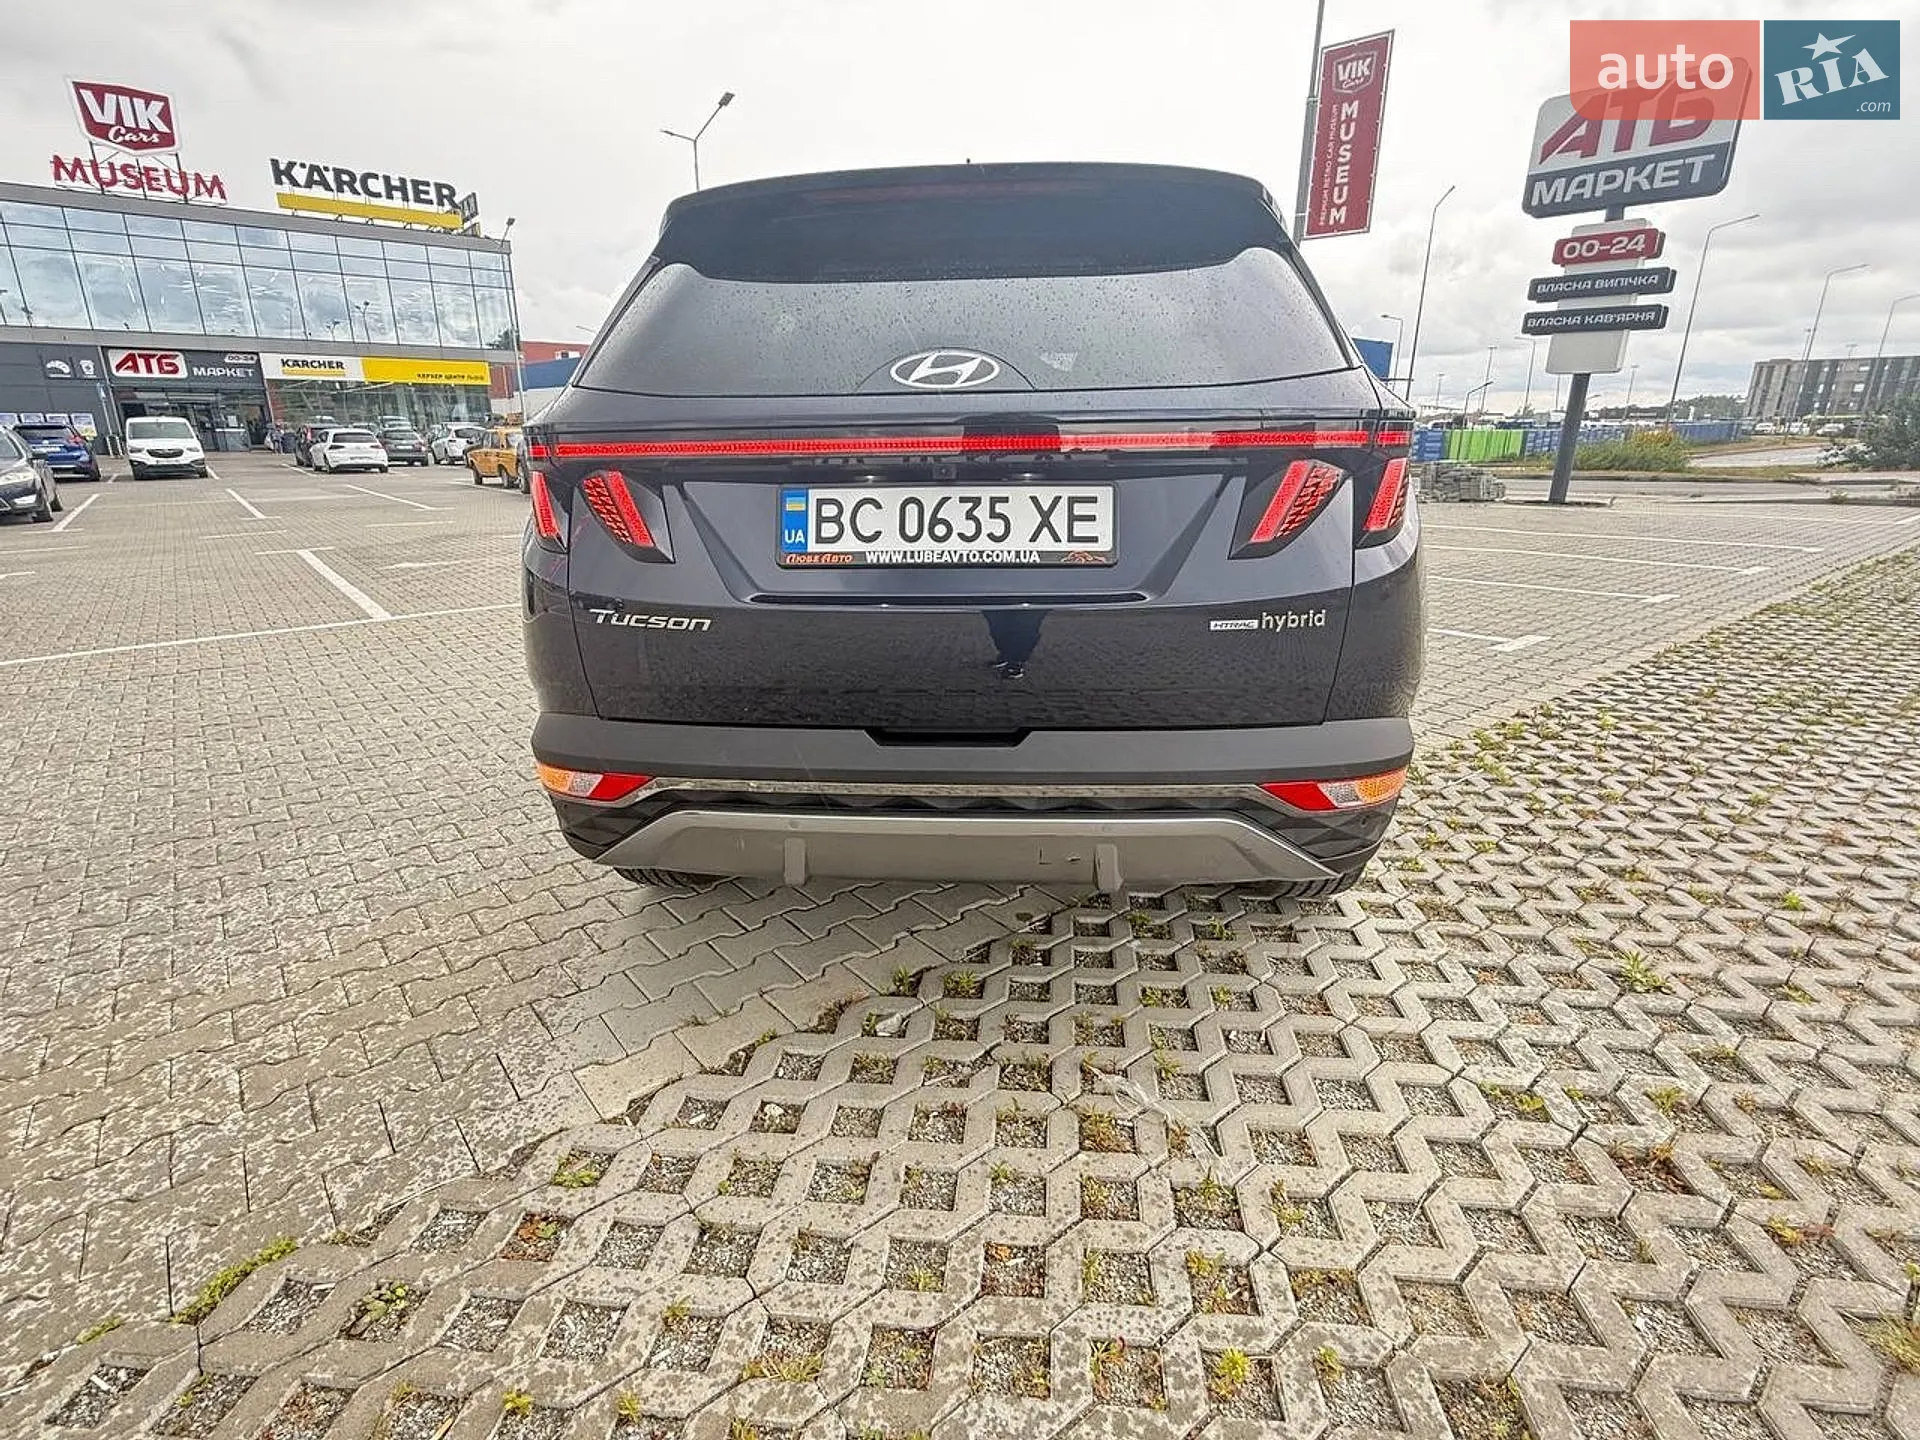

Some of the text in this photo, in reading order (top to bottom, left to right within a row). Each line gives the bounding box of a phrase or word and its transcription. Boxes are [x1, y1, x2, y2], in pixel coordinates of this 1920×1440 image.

[1337, 57, 1371, 82] VIK
[79, 88, 171, 133] VIK
[108, 126, 161, 143] Cars
[1329, 99, 1359, 226] MUSEUM
[53, 154, 227, 200] MUSEUM
[270, 158, 462, 210] KÄRCHER
[1531, 153, 1716, 207] МАРКЕТ
[1563, 233, 1647, 259] 00-24
[1537, 274, 1659, 294] ВЛАСНА ВИПІЧКА
[1527, 313, 1581, 328] ВЛАСНА
[115, 352, 180, 375] АТБ
[193, 366, 255, 378] МАРКЕТ
[815, 495, 1099, 544] BC 0635 XE
[785, 530, 805, 544] UA
[865, 550, 1040, 564] WWW.LUBEAVTO.COM.UA
[1262, 609, 1326, 632] hybrid
